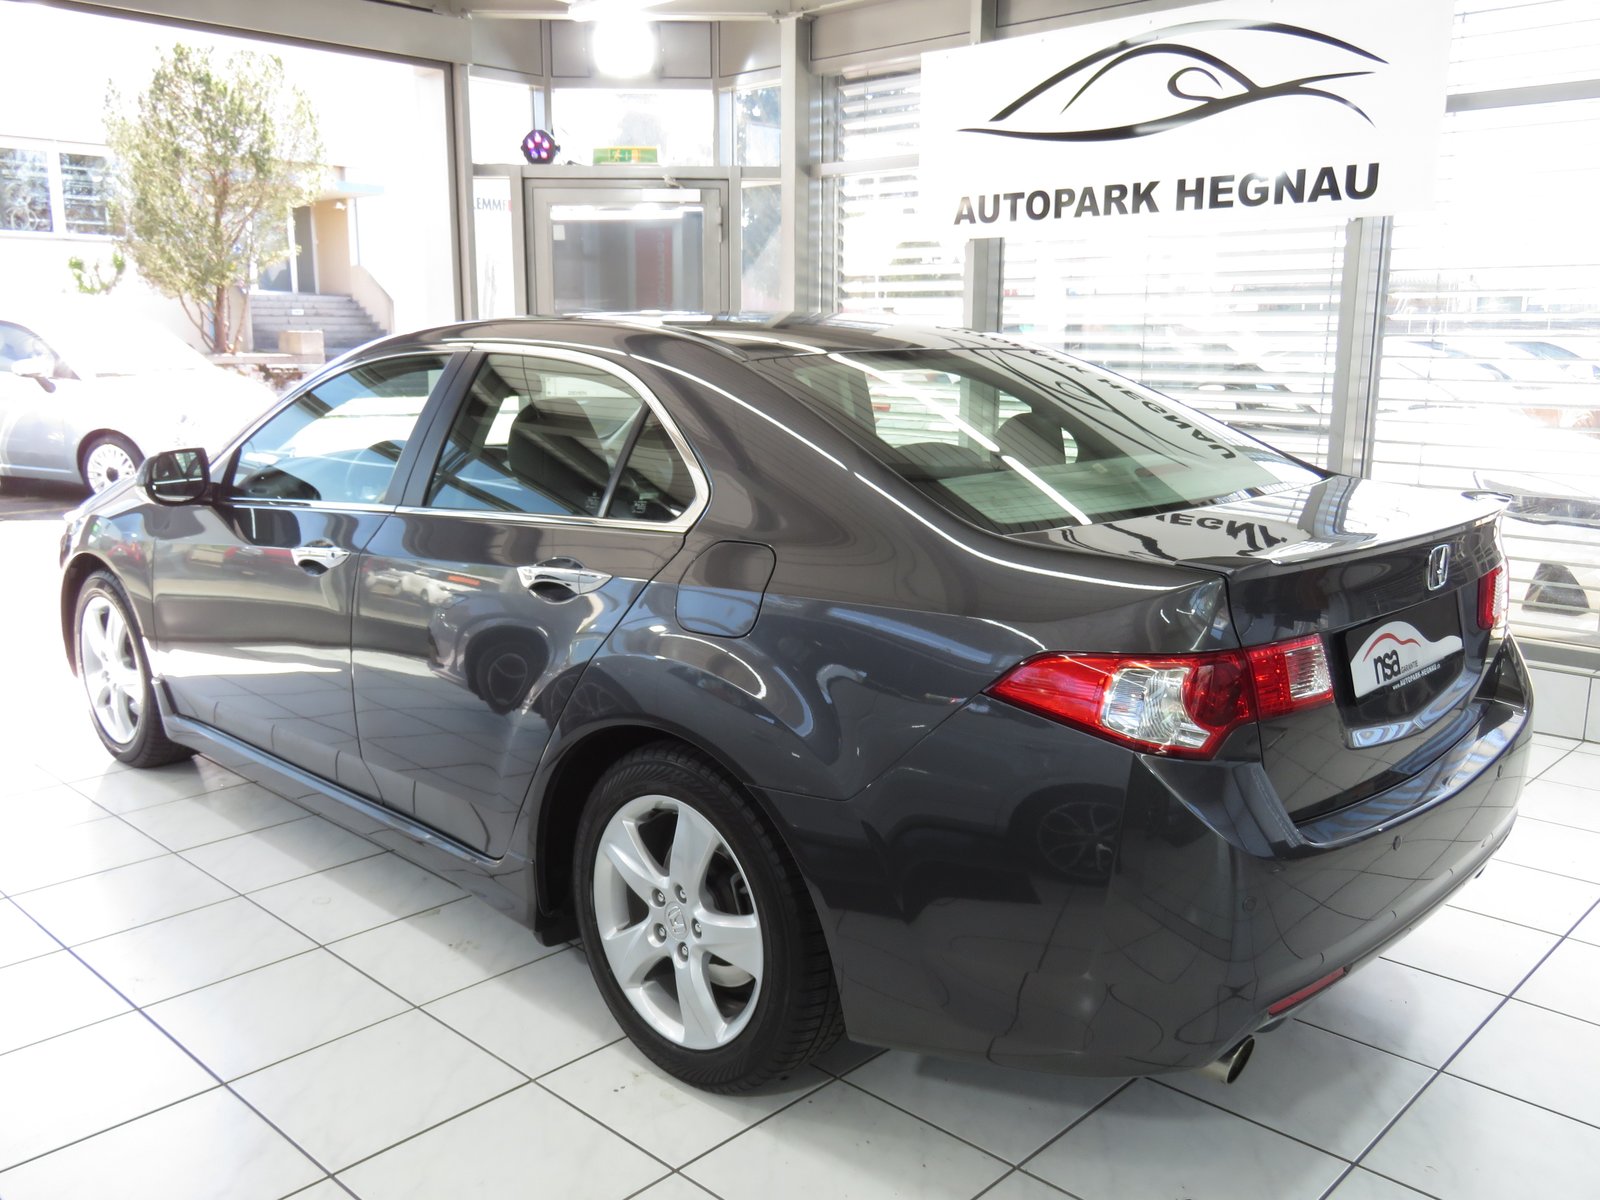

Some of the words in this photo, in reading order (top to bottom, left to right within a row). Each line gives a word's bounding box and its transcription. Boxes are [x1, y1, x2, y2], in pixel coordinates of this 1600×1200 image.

[954, 181, 1160, 225] AUTOPARK
[1176, 162, 1380, 211] HEGNAU
[1373, 649, 1402, 685] nsa
